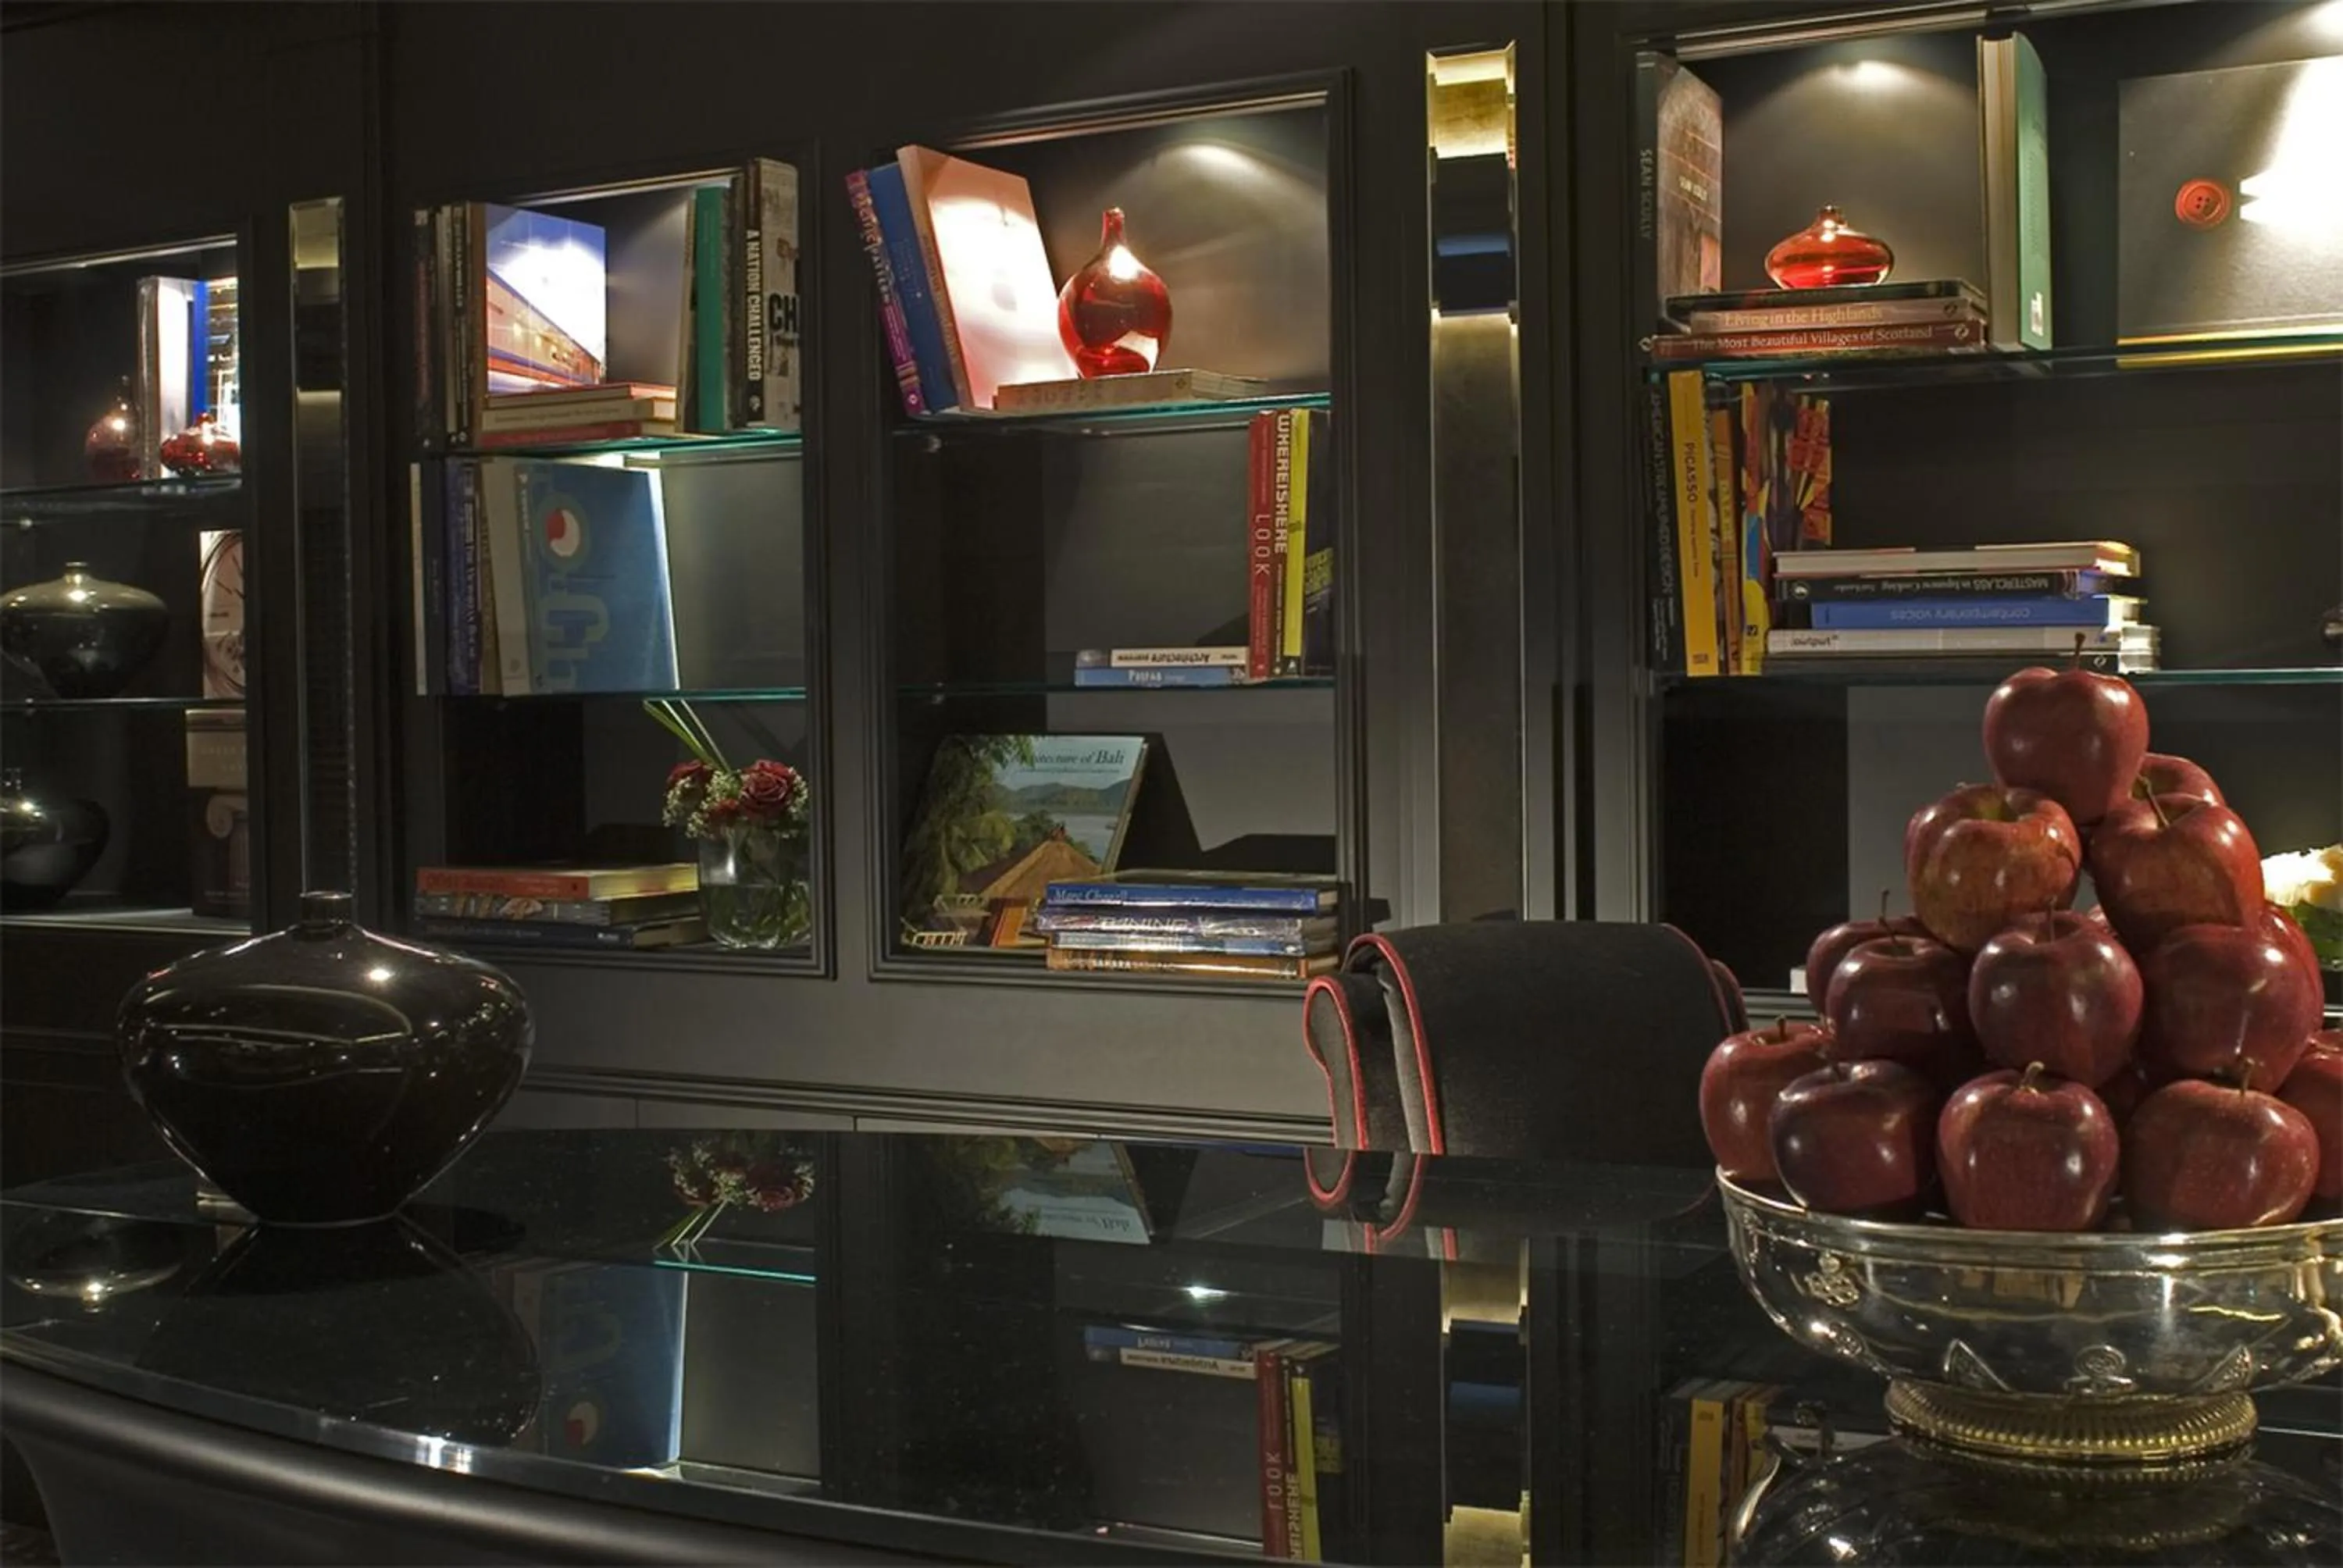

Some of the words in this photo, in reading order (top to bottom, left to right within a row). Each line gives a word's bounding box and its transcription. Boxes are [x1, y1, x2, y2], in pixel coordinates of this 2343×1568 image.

[1639, 148, 1653, 187] SEAN
[1639, 190, 1653, 239] SCULLY
[747, 230, 759, 240] A
[747, 241, 761, 291] NATION
[1724, 312, 1770, 327] Living
[1786, 311, 1808, 324] the
[1811, 305, 1882, 323] Highlands
[747, 294, 762, 381] CHALLENGED
[1693, 338, 1716, 350] The
[1717, 337, 1749, 349] Most
[1751, 333, 1808, 348] Beautiful
[1810, 330, 1860, 346] Villages
[1860, 329, 1874, 342] of
[1877, 325, 1932, 341] Scotland
[1685, 442, 1698, 502] PICASSO
[1254, 513, 1271, 576] LOOK
[1974, 577, 2049, 590] MASTERCLASS
[1890, 608, 1933, 621] voices
[1935, 607, 2031, 622] contemporary
[1096, 748, 1125, 764] Bali
